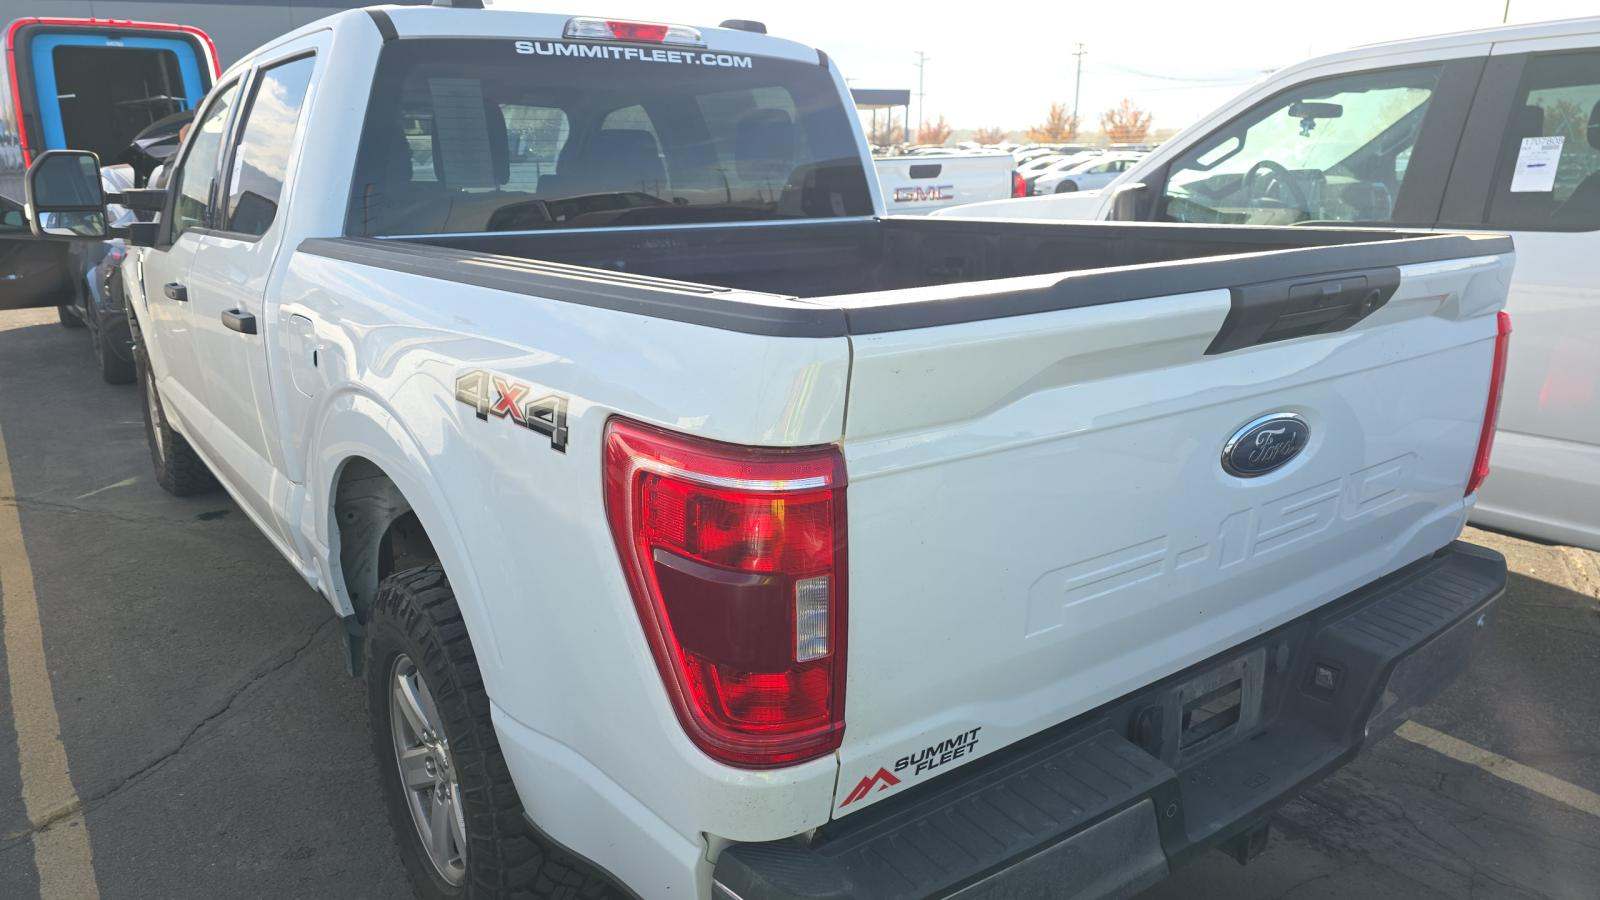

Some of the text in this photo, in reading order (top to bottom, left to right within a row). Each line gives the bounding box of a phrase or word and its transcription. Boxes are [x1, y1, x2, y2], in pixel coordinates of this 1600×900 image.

[515, 40, 753, 68] SUMMITFLEET.COM
[893, 185, 954, 203] GMC
[1249, 427, 1297, 462] Ford
[1024, 451, 1419, 640] F-150
[893, 726, 982, 772] SUMMIT
[915, 739, 979, 776] FLEET
